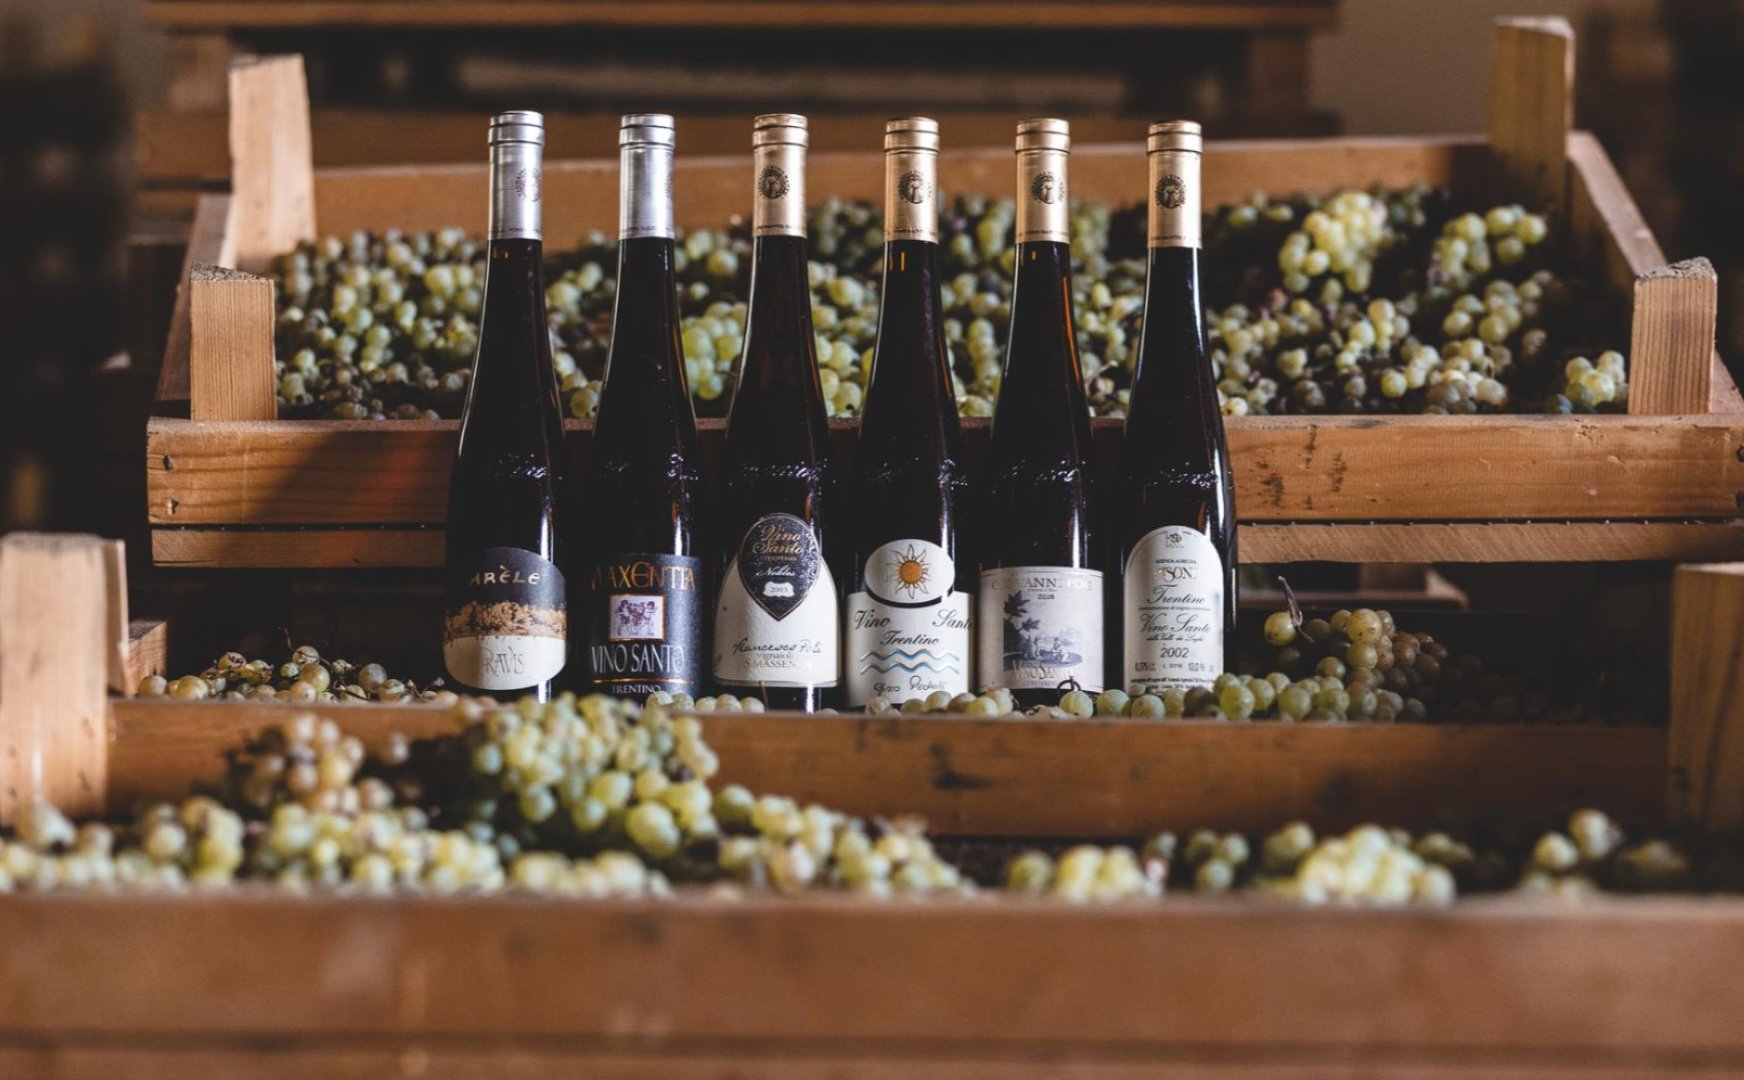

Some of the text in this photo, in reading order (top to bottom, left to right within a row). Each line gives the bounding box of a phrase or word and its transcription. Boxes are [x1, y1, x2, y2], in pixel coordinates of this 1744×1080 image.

[760, 524, 801, 542] Vino
[1146, 584, 1204, 604] Trentino
[854, 609, 891, 630] Vino
[1140, 612, 1168, 632] Vino
[880, 630, 940, 646] Trentino
[592, 643, 685, 673] VINO SANTO
[1160, 647, 1190, 658] 2002
[612, 684, 662, 694] TRENTINO
